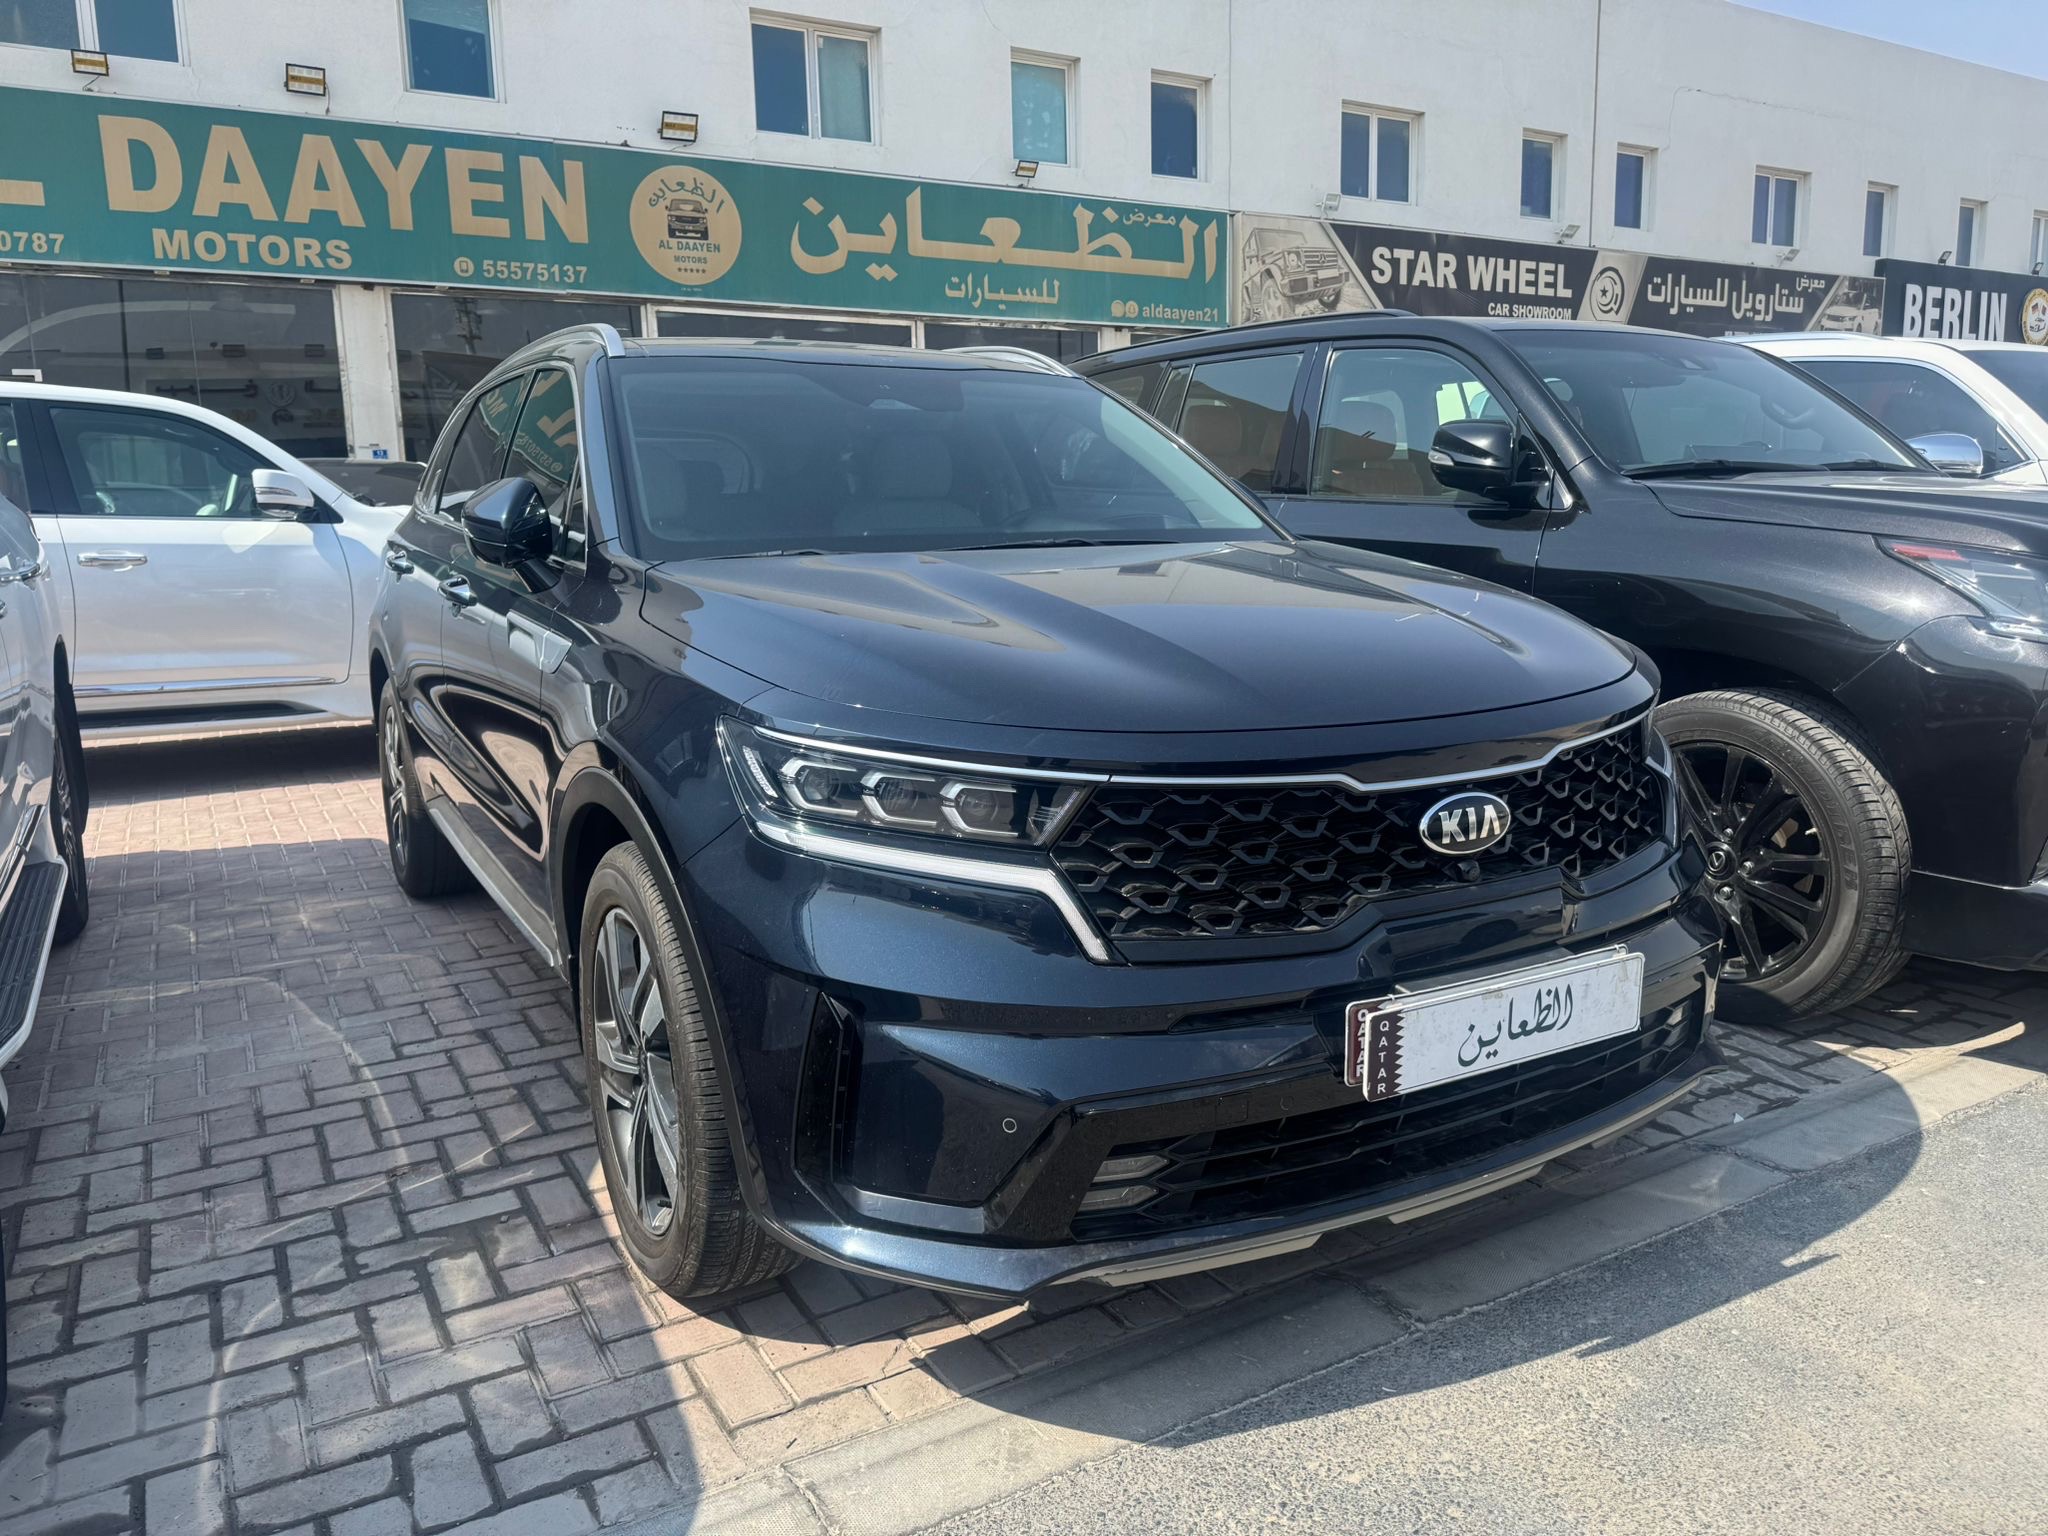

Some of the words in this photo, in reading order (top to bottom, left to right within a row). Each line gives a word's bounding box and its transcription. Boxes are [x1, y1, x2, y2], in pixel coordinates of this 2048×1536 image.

[98, 114, 589, 244] DAAYEN
[790, 186, 1218, 284] الظعاين
[1122, 207, 1176, 227] معرض
[152, 227, 352, 269] MOTORS
[658, 239, 673, 250] AL
[676, 240, 721, 253] DAAYEN
[673, 255, 708, 264] MOTORS
[482, 259, 588, 283] 55575137
[945, 272, 1060, 310] للسيارات
[1371, 246, 1457, 289] STAR
[1467, 255, 1573, 298] WHEEL
[1796, 275, 1825, 292] معرض
[1142, 301, 1219, 323] aldaayen21
[1488, 302, 1510, 317] CAR
[1512, 304, 1572, 320] SHOWROOM
[1647, 273, 1728, 314] للسيارات
[1732, 279, 1803, 321] ستارويل
[1902, 284, 2007, 341] BERLIN
[1438, 804, 1501, 844] KIA
[1458, 984, 1573, 1067] الظعاين
[1377, 1020, 1389, 1094] QATAR
